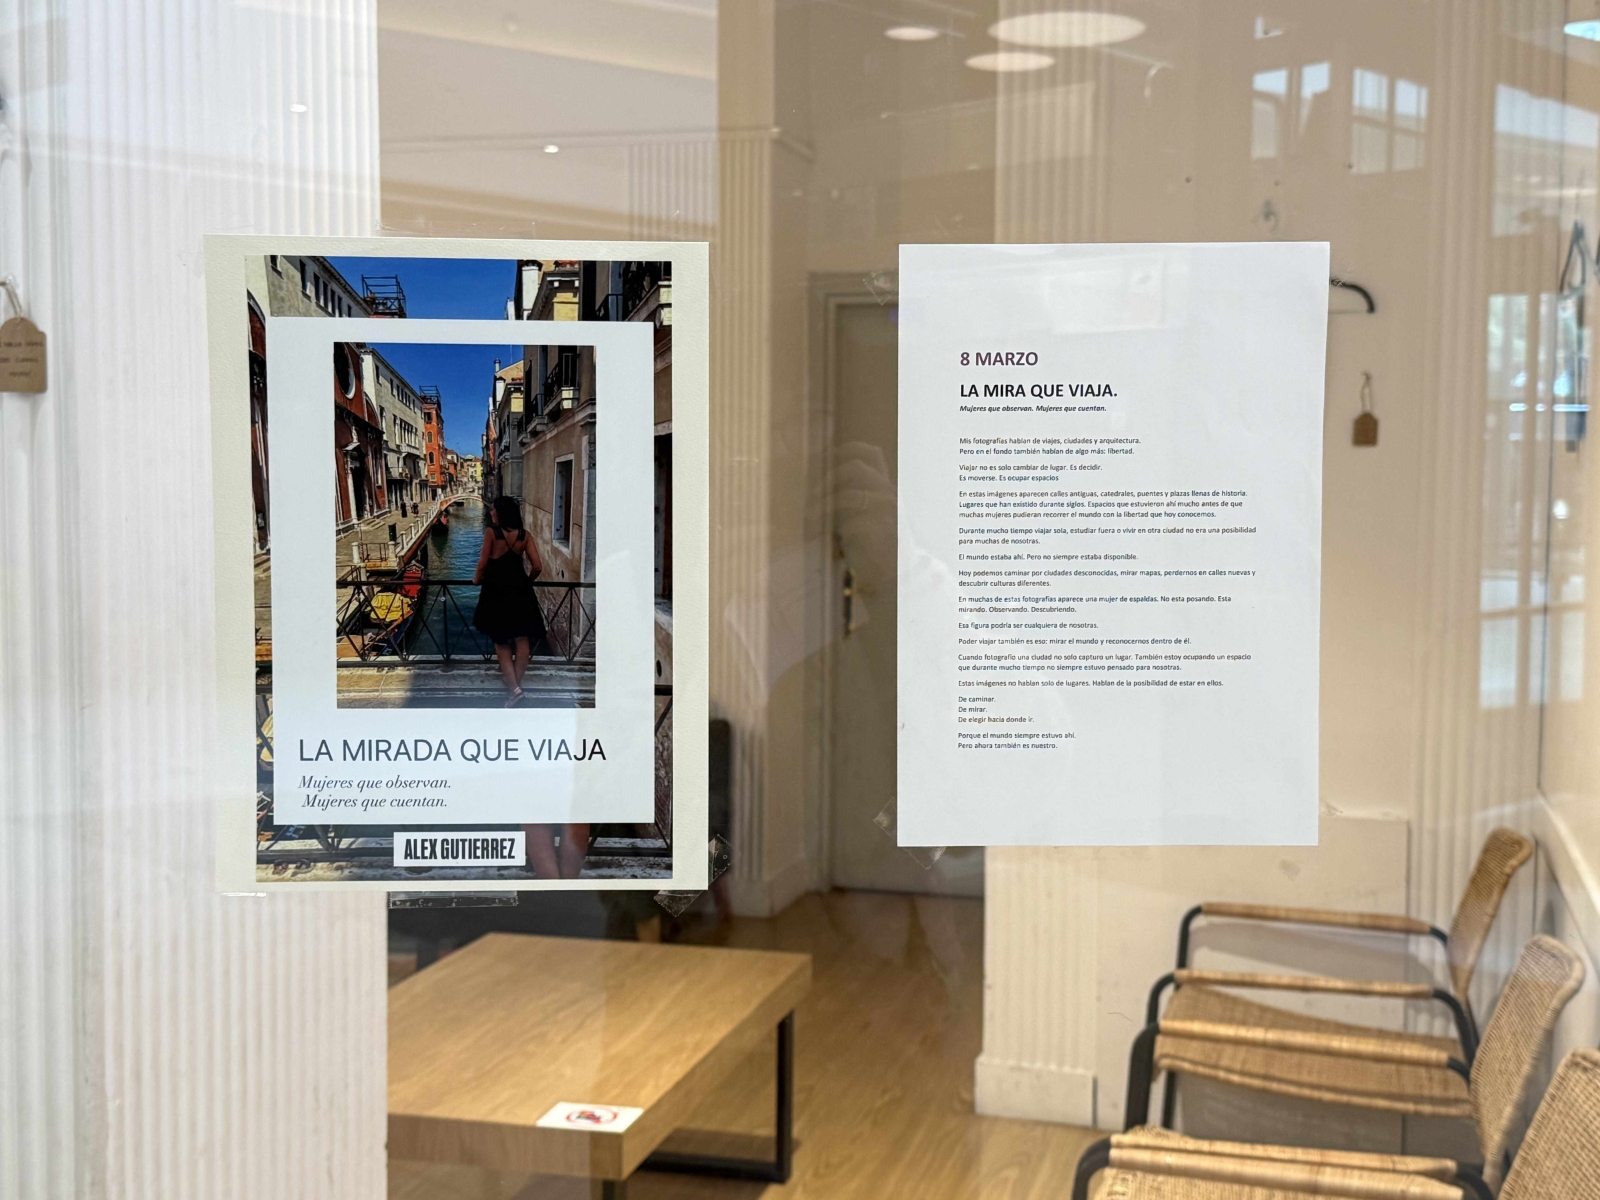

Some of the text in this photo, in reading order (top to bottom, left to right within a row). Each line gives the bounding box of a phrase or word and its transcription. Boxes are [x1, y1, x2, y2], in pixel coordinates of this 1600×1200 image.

[960, 352, 1038, 366] 8 MARZO
[961, 384, 1117, 399] LA MIRA QUE VIAJA.
[960, 405, 986, 413] Mujeres
[1036, 404, 1063, 413] Mujeres
[1042, 437, 1062, 445] viajes,
[1099, 437, 1141, 445] arquitectura.
[1075, 447, 1089, 456] algo
[959, 464, 978, 472] Viajar
[1050, 463, 1068, 472] lugar.
[1007, 475, 1030, 483] ocupar
[1031, 474, 1059, 483] espacios
[987, 490, 1018, 499] imágenes
[1019, 491, 1048, 499] aparecen
[1070, 490, 1099, 499] antiguas,
[1100, 490, 1135, 499] catedrales,
[1137, 490, 1163, 498] puentes
[1170, 490, 1190, 498] plazas
[985, 510, 1011, 519] mujeres
[1013, 510, 1041, 519] pudieran
[1164, 510, 1176, 519] hoy
[1053, 553, 1079, 562] siempre
[1103, 553, 1138, 562] disponible.
[959, 569, 971, 578] Hoy
[973, 569, 1003, 578] podemos
[1032, 570, 1042, 578] por
[1074, 569, 1119, 578] desconocidas,
[1140, 570, 1162, 578] mapas,
[1164, 569, 1197, 578] perdernos
[990, 579, 1016, 587] culturas
[1017, 579, 1051, 587] diferentes.
[989, 605, 1029, 613] Observando.
[971, 622, 989, 630] figura
[991, 621, 1011, 630] podría
[1024, 621, 1057, 630] cualquiera
[999, 663, 1021, 671] mucho
[1023, 663, 1045, 672] tiempo
[1057, 663, 1082, 672] siempre
[1107, 663, 1134, 672] pensado
[968, 716, 986, 724] elegir
[988, 715, 1004, 723] hacia
[1006, 715, 1026, 723] donde
[958, 732, 981, 740] Porque
[990, 731, 1012, 739] mundo
[1014, 731, 1040, 740] siempre
[995, 741, 1021, 749] también
[299, 738, 607, 764] LA MIRADA QUE VIAJA
[298, 774, 451, 793] Mujeres que observan.
[301, 794, 447, 812] Mujeres que cuentan.
[404, 838, 516, 860] ALEX GUTIERREZ
